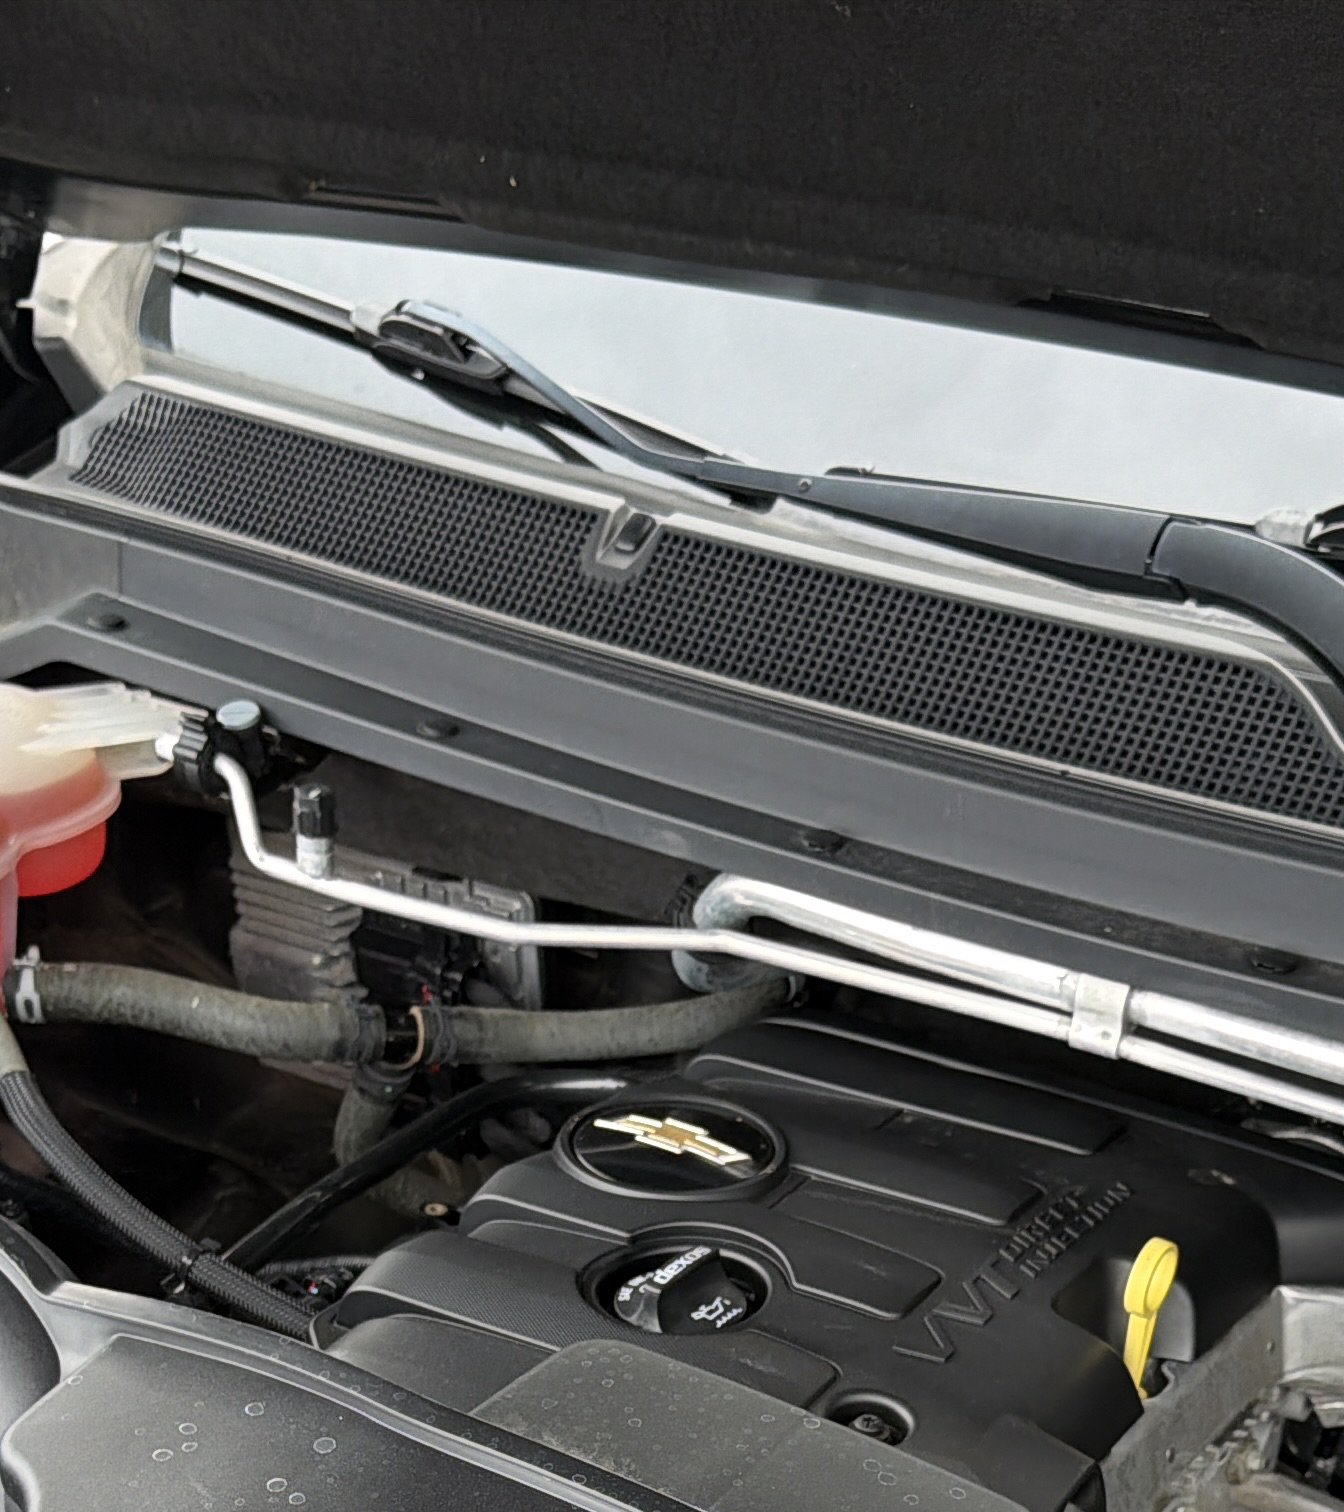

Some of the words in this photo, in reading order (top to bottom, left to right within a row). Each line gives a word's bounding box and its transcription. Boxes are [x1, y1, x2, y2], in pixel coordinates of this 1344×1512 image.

[653, 1246, 713, 1285] dexos
[999, 1184, 1086, 1263] DIRECT
[1019, 1182, 1136, 1279] INJECTION
[892, 1258, 1021, 1363] VVT
